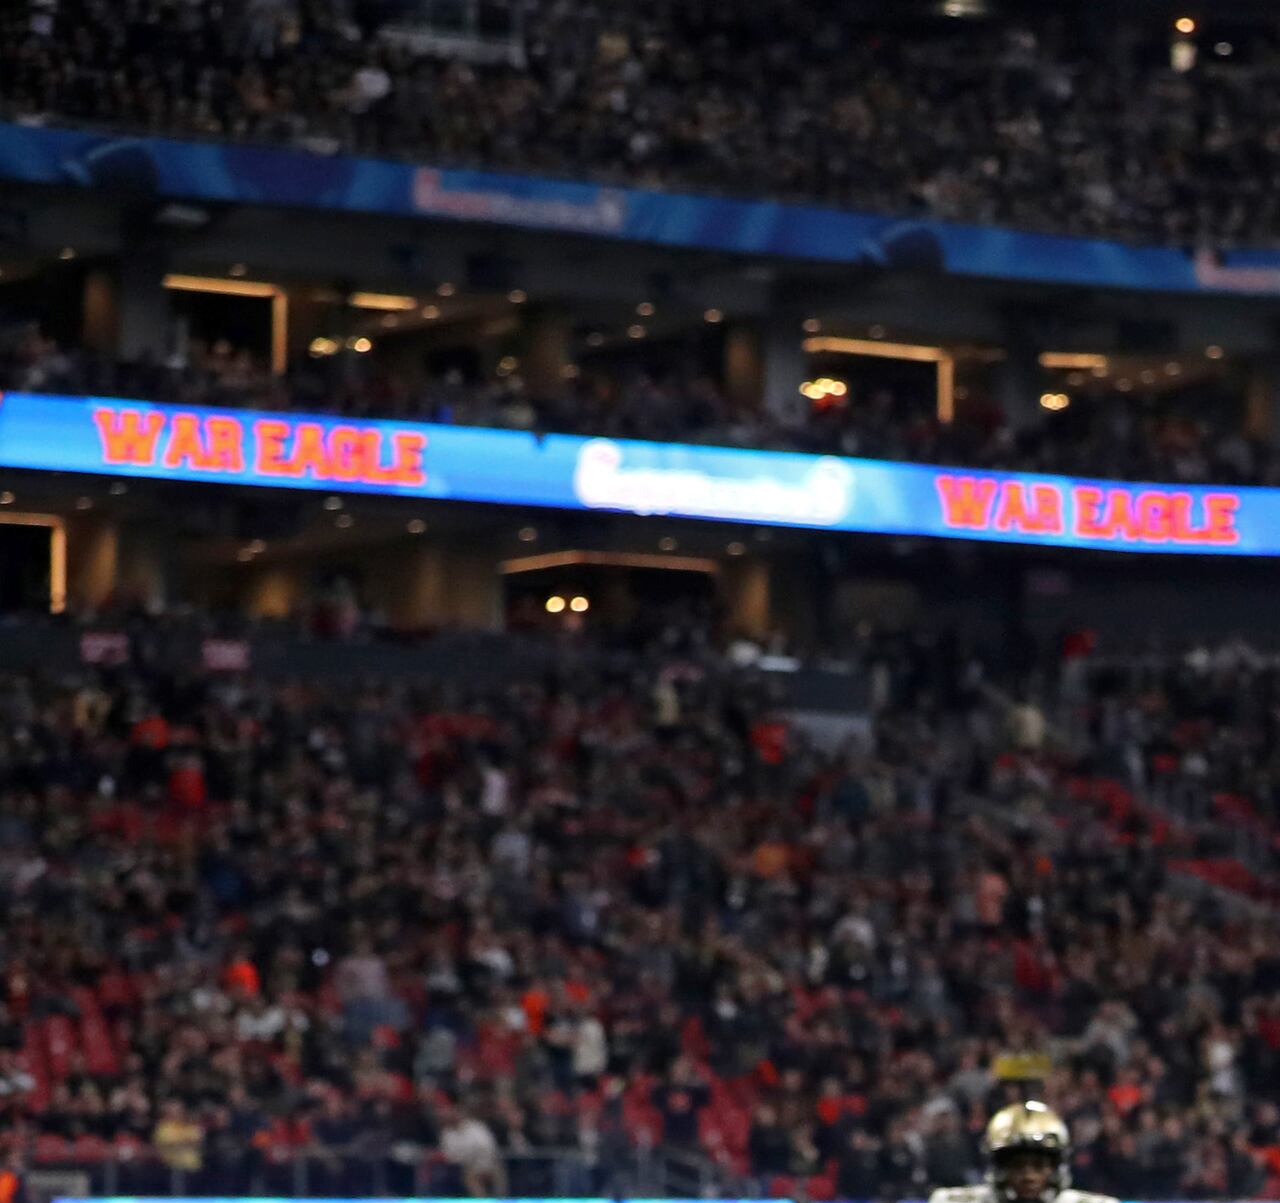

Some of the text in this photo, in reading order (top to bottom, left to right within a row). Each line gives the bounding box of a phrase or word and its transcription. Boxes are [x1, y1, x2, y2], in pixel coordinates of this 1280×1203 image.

[93, 409, 427, 487] WAR EAGLE
[935, 474, 1240, 546] WAR EAGLE
